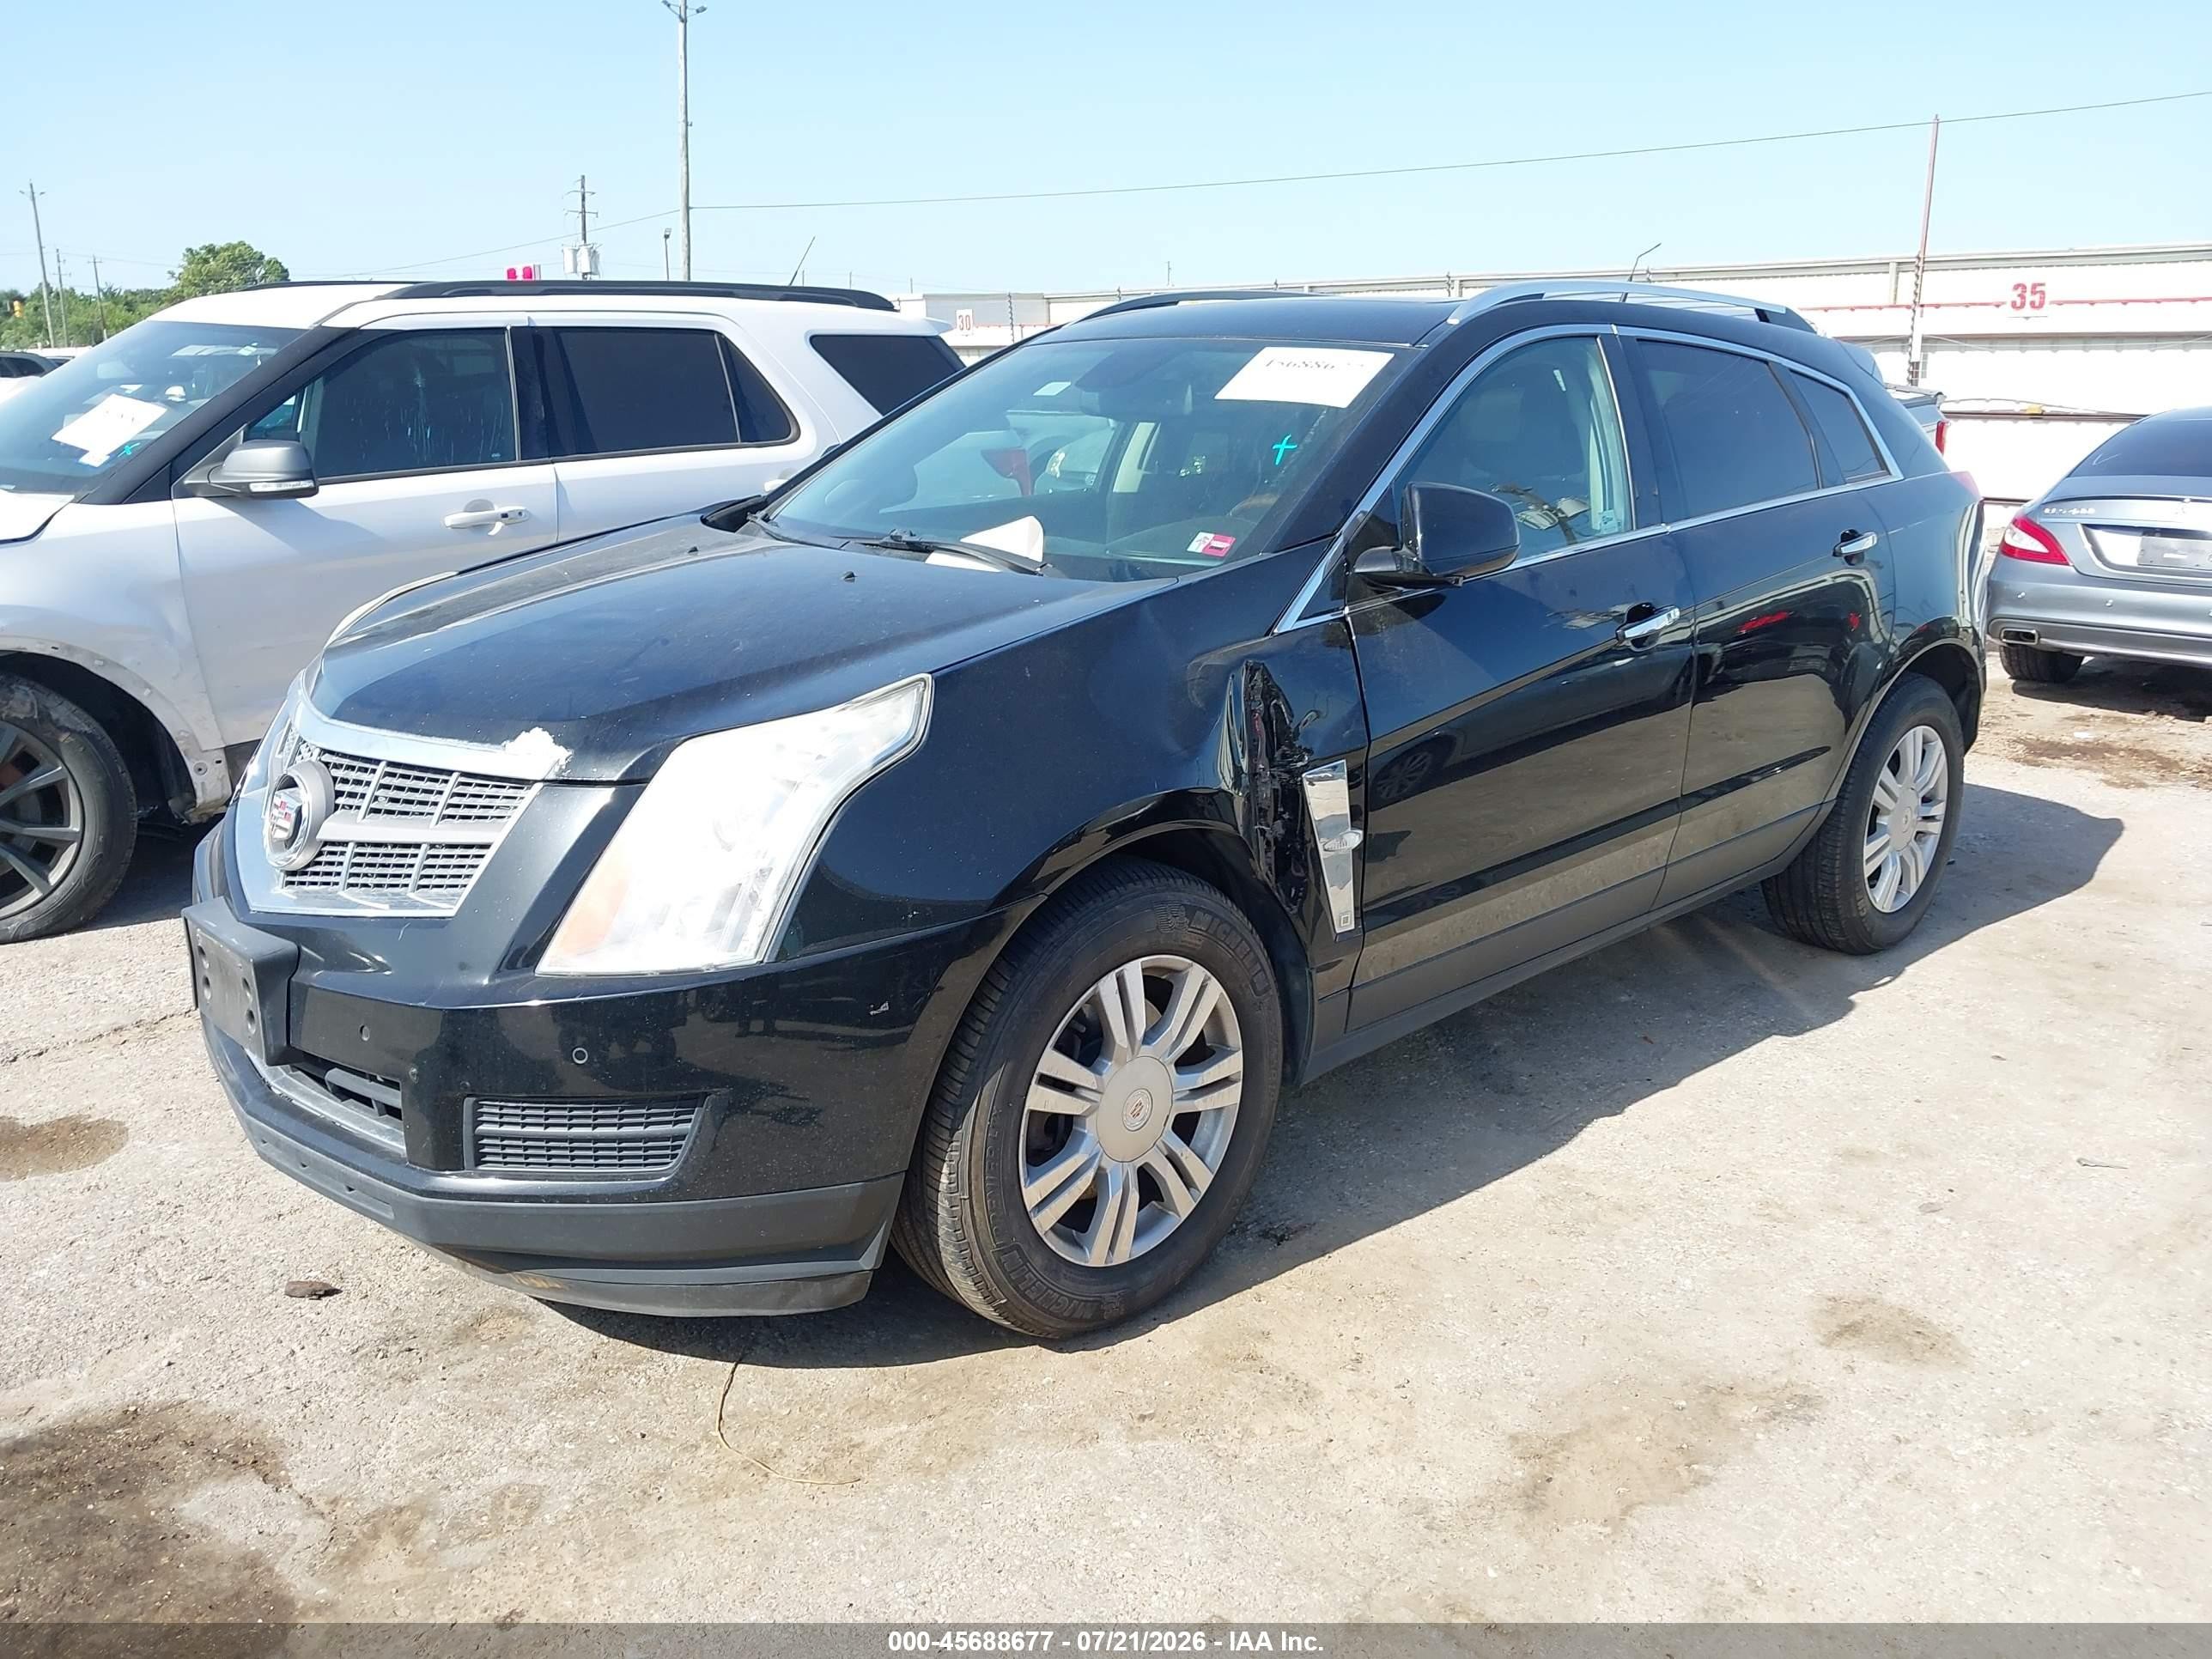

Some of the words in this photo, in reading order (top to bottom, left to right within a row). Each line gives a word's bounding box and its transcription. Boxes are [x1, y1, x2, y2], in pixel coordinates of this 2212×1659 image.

[2011, 283, 2045, 310] 35
[958, 314, 970, 331] 30
[1189, 910, 1270, 990] MICHELIN
[1000, 1249, 1103, 1320] MICHELIN
